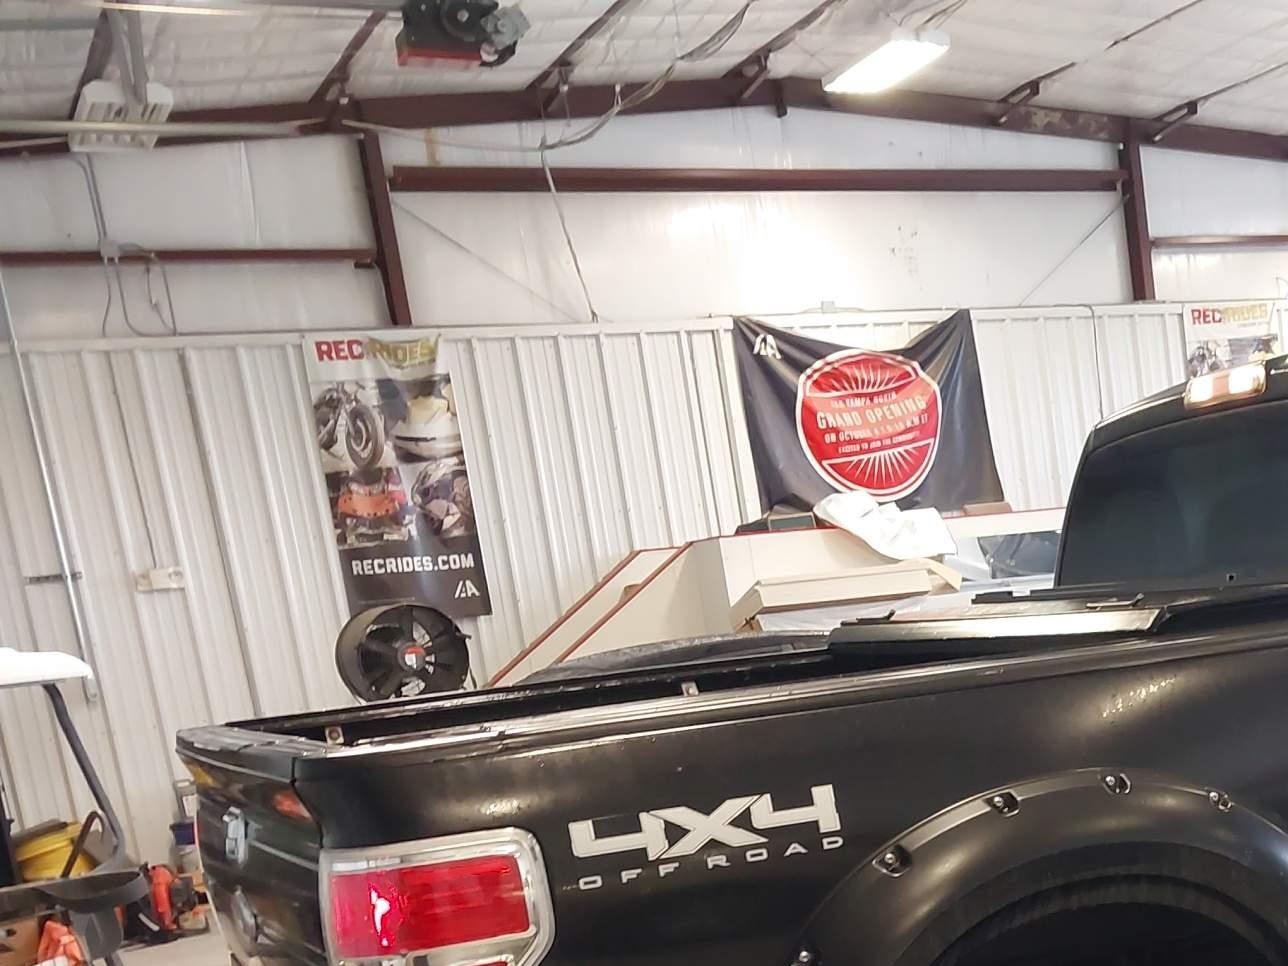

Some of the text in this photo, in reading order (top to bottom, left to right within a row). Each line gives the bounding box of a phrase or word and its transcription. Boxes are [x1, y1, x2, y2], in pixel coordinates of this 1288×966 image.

[1191, 307, 1222, 325] REC
[315, 339, 365, 362] REC
[816, 409, 863, 430] GRAND
[865, 395, 927, 425] OPENING
[351, 552, 475, 576] RECRIDES.COM
[567, 783, 842, 861] 4X4
[578, 836, 844, 891] OFF ROAD
